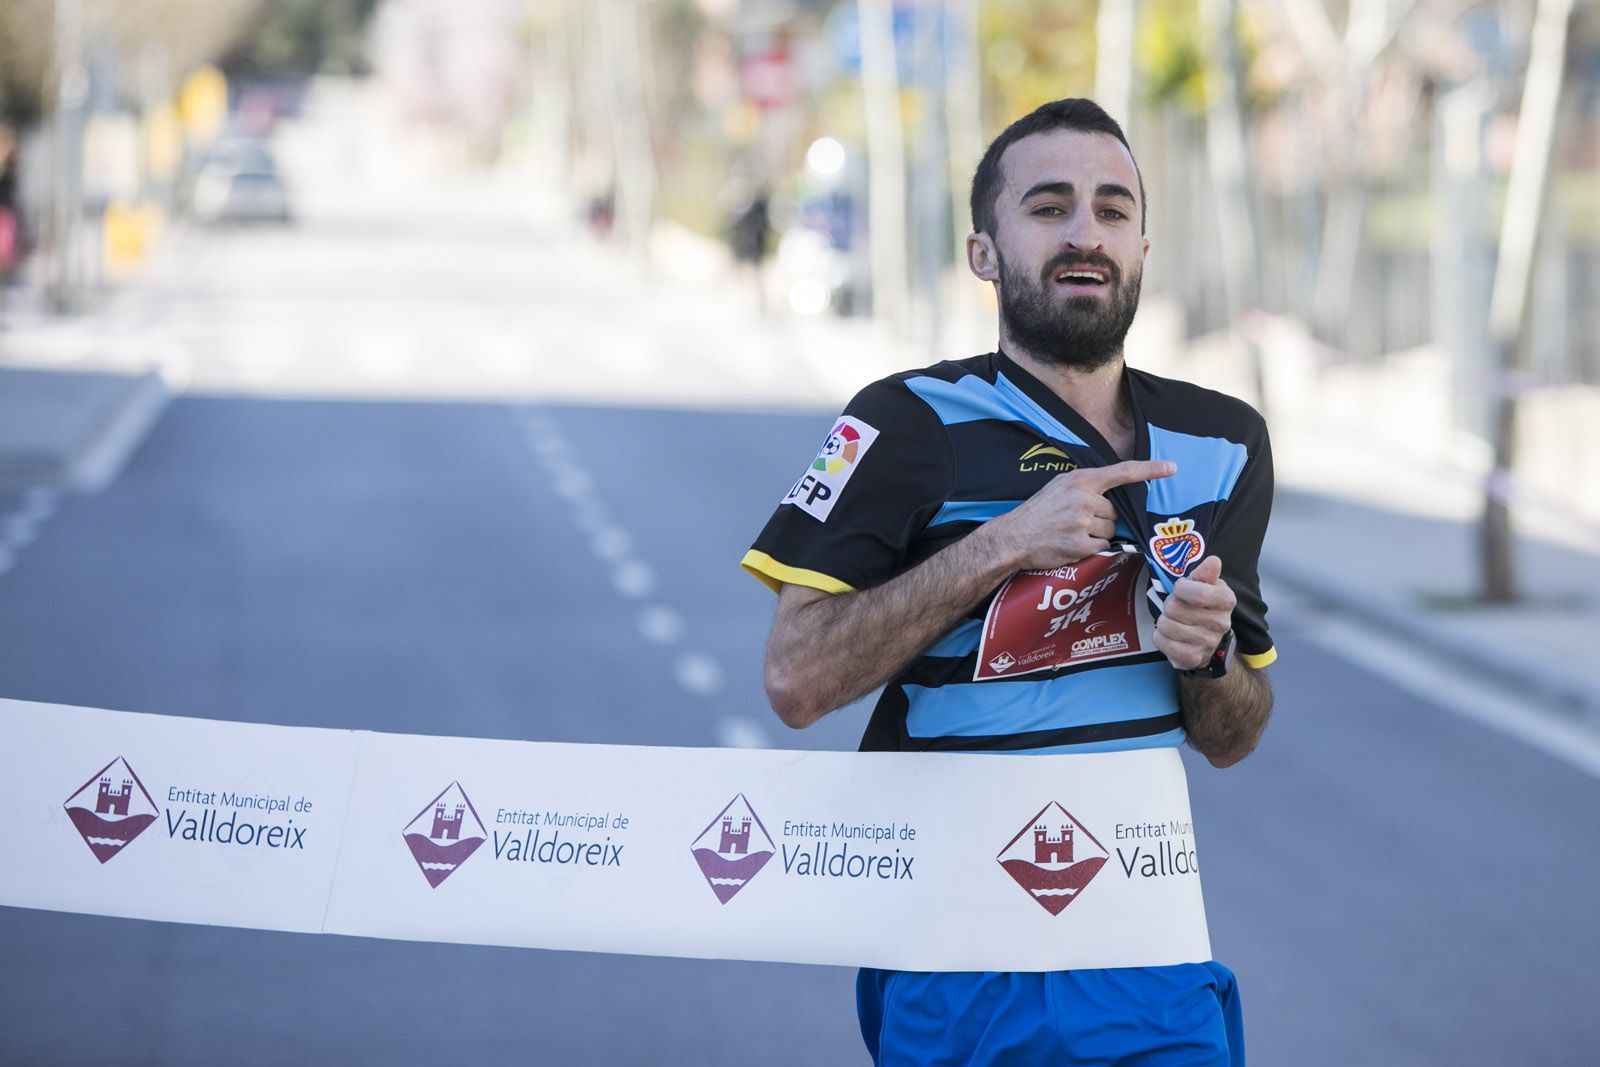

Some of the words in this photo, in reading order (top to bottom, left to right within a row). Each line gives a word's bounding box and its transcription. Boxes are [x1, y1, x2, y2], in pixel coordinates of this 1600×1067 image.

[787, 474, 832, 506] LFP
[1036, 571, 1119, 612] JOSEP
[1043, 599, 1094, 638] 314
[1017, 648, 1056, 666] Valldoreix
[1071, 632, 1128, 652] COMPLEX
[168, 786, 217, 806] Entitat
[220, 791, 290, 814] Municipal
[294, 796, 313, 813] de
[166, 808, 307, 850] Valldoreix
[496, 808, 541, 826] Entitat
[543, 811, 609, 832] Municipal
[612, 813, 629, 830] de
[783, 820, 827, 838] Entitat
[831, 822, 895, 844] Municipal
[899, 823, 916, 841] de
[1115, 822, 1167, 840] Entitat
[493, 828, 624, 867] Valldoreix
[782, 841, 914, 880] Valldoreix
